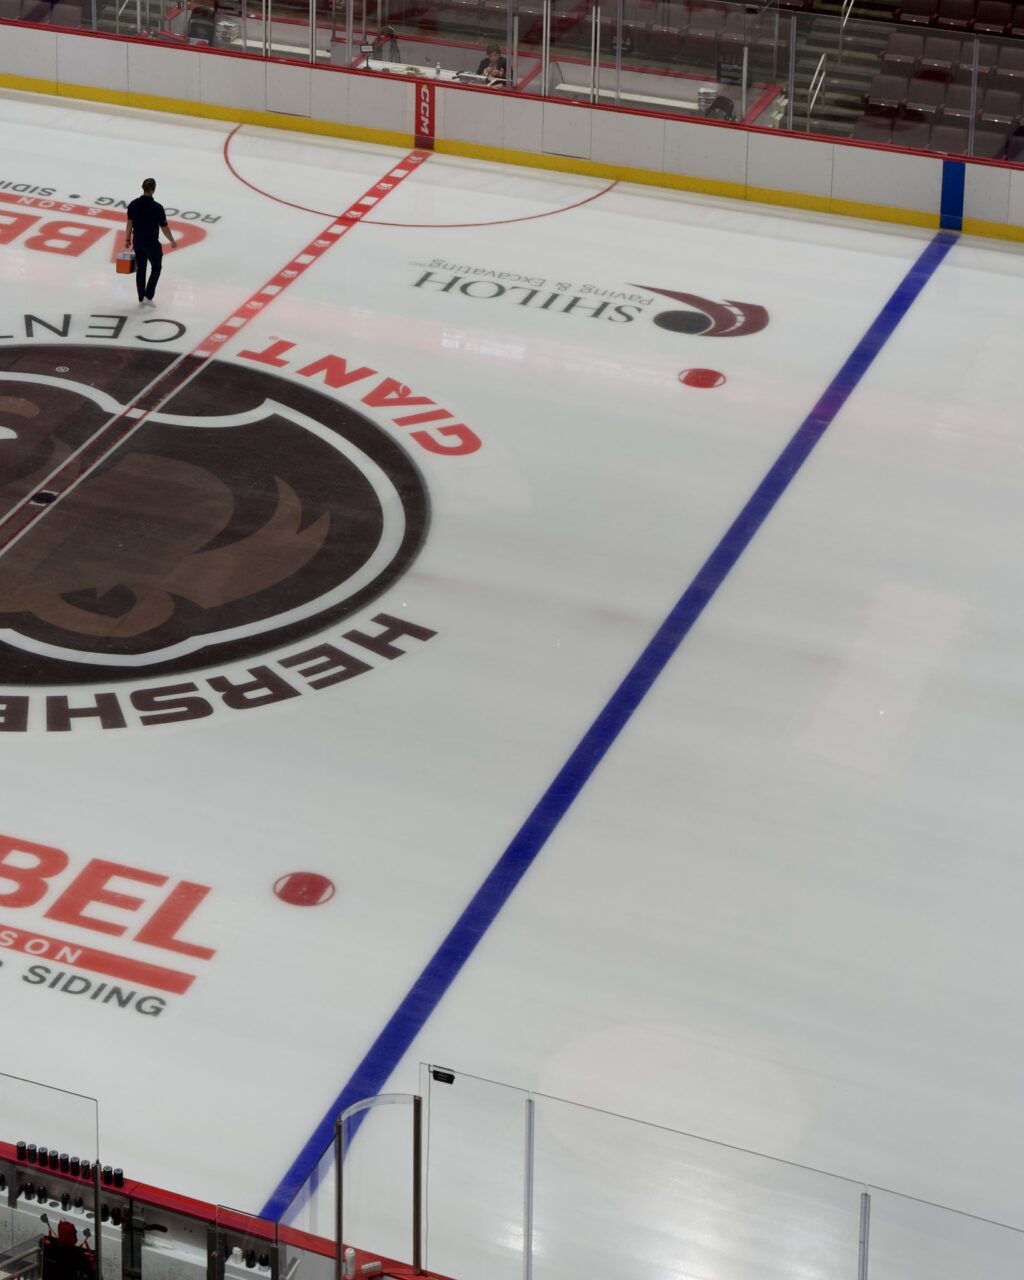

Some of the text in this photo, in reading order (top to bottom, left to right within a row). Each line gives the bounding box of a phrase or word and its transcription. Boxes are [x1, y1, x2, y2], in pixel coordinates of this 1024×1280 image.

[420, 87, 430, 135] CCM
[16, 196, 73, 213] SON
[95, 196, 222, 225] ROONG
[411, 270, 643, 324] SHILOH
[430, 258, 657, 307] Paving & Excavating
[237, 338, 482, 456] GIANT
[21, 965, 168, 1018] SIDING
